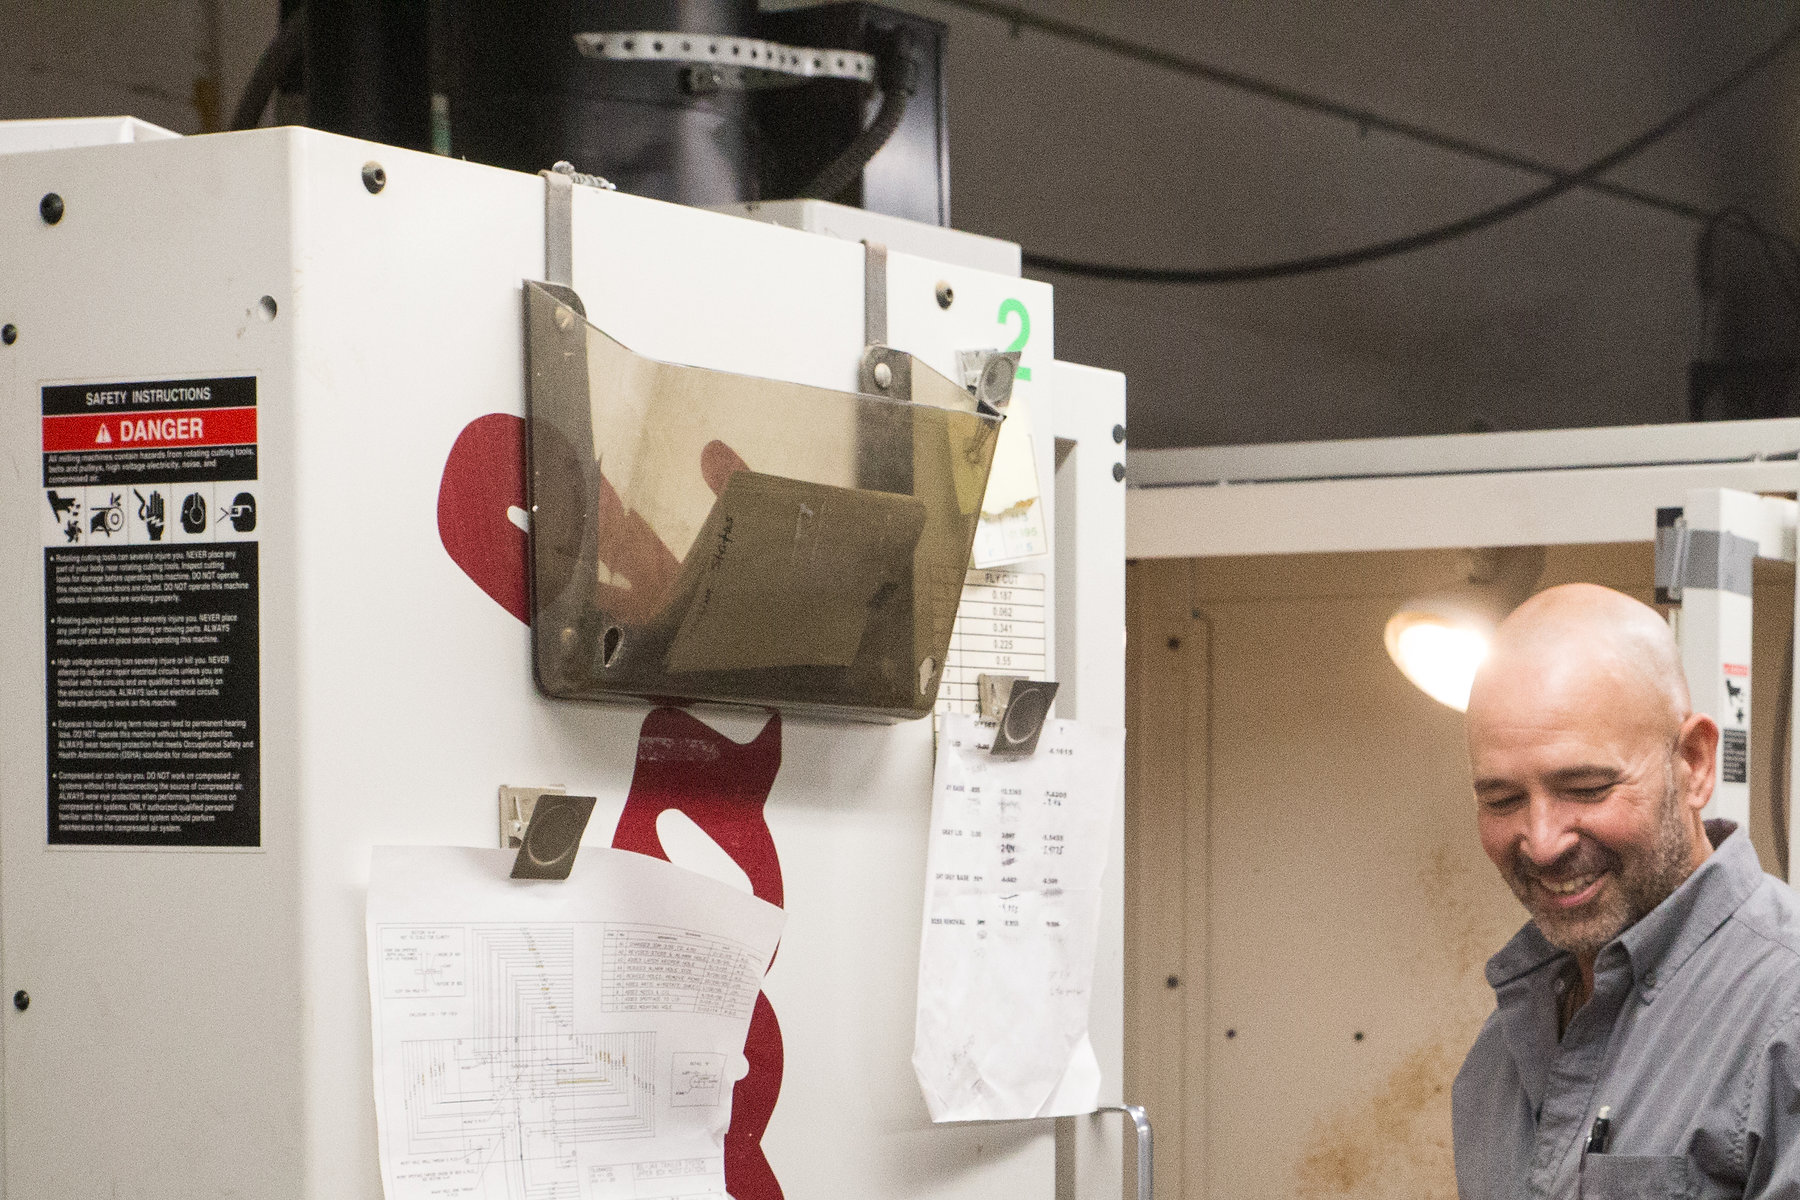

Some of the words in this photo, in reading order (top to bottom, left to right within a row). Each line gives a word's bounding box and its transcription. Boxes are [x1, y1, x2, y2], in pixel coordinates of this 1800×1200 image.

[998, 298, 1031, 381] 2
[86, 391, 126, 406] SAFETY
[132, 388, 212, 403] INSTRUCTIONS
[120, 418, 203, 442] DANGER
[185, 550, 206, 558] NEVER
[198, 613, 220, 621] NEVER
